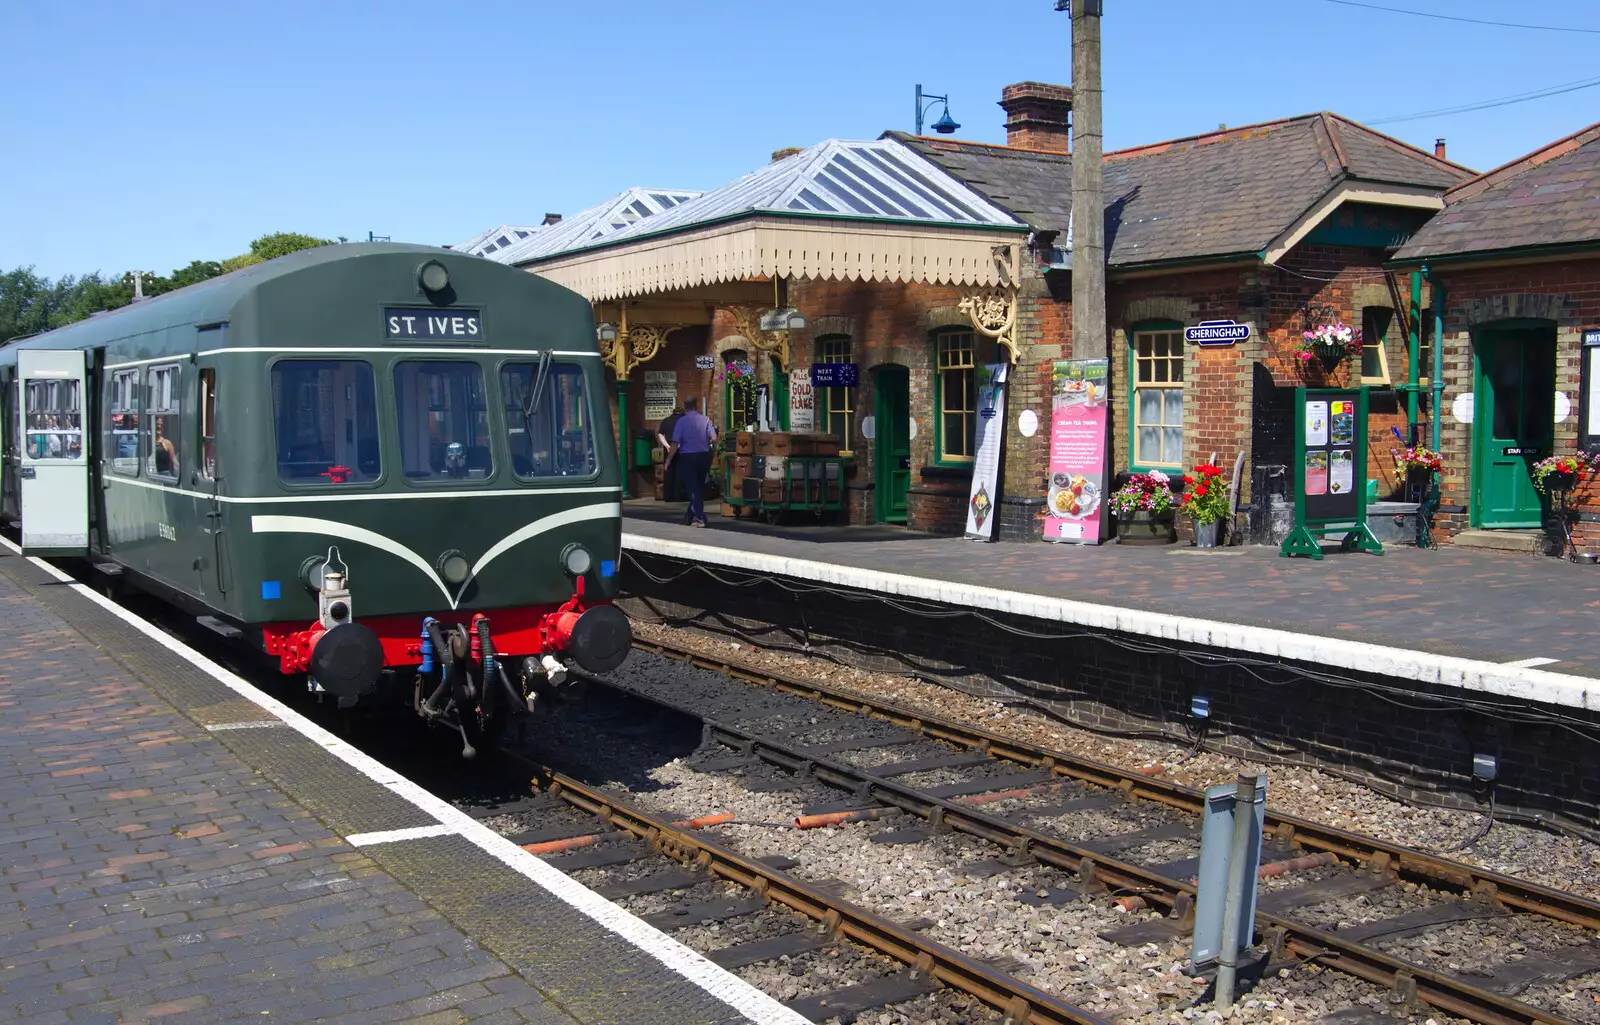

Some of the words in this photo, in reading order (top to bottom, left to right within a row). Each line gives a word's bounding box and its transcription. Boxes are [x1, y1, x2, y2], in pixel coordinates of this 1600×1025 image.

[389, 316, 417, 335] ST.
[428, 316, 478, 335] IVES
[1190, 327, 1245, 339] SHERINGHAM
